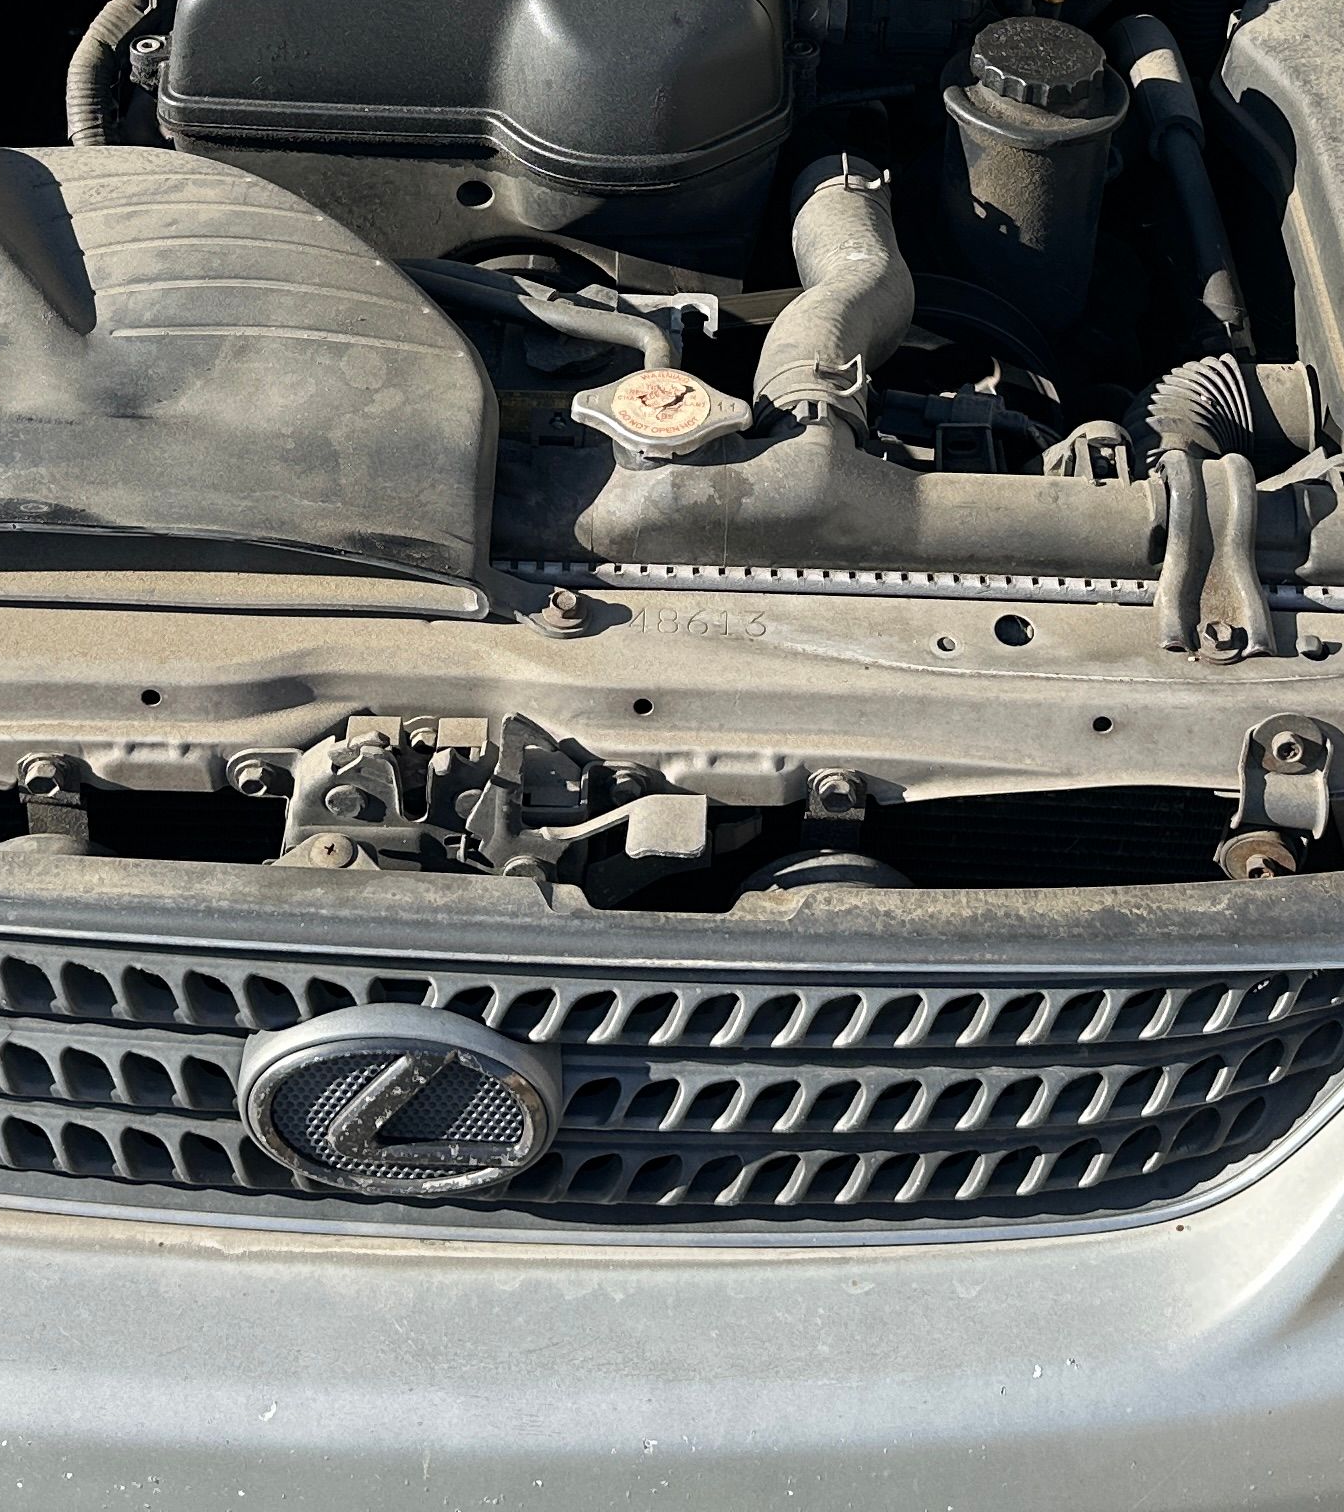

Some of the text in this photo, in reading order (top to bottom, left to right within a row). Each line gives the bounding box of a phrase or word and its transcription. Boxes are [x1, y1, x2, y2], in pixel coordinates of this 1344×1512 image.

[640, 372, 690, 384] WARNING
[619, 409, 700, 434] DO NOT OPEN HOT
[629, 606, 767, 637] 48613
